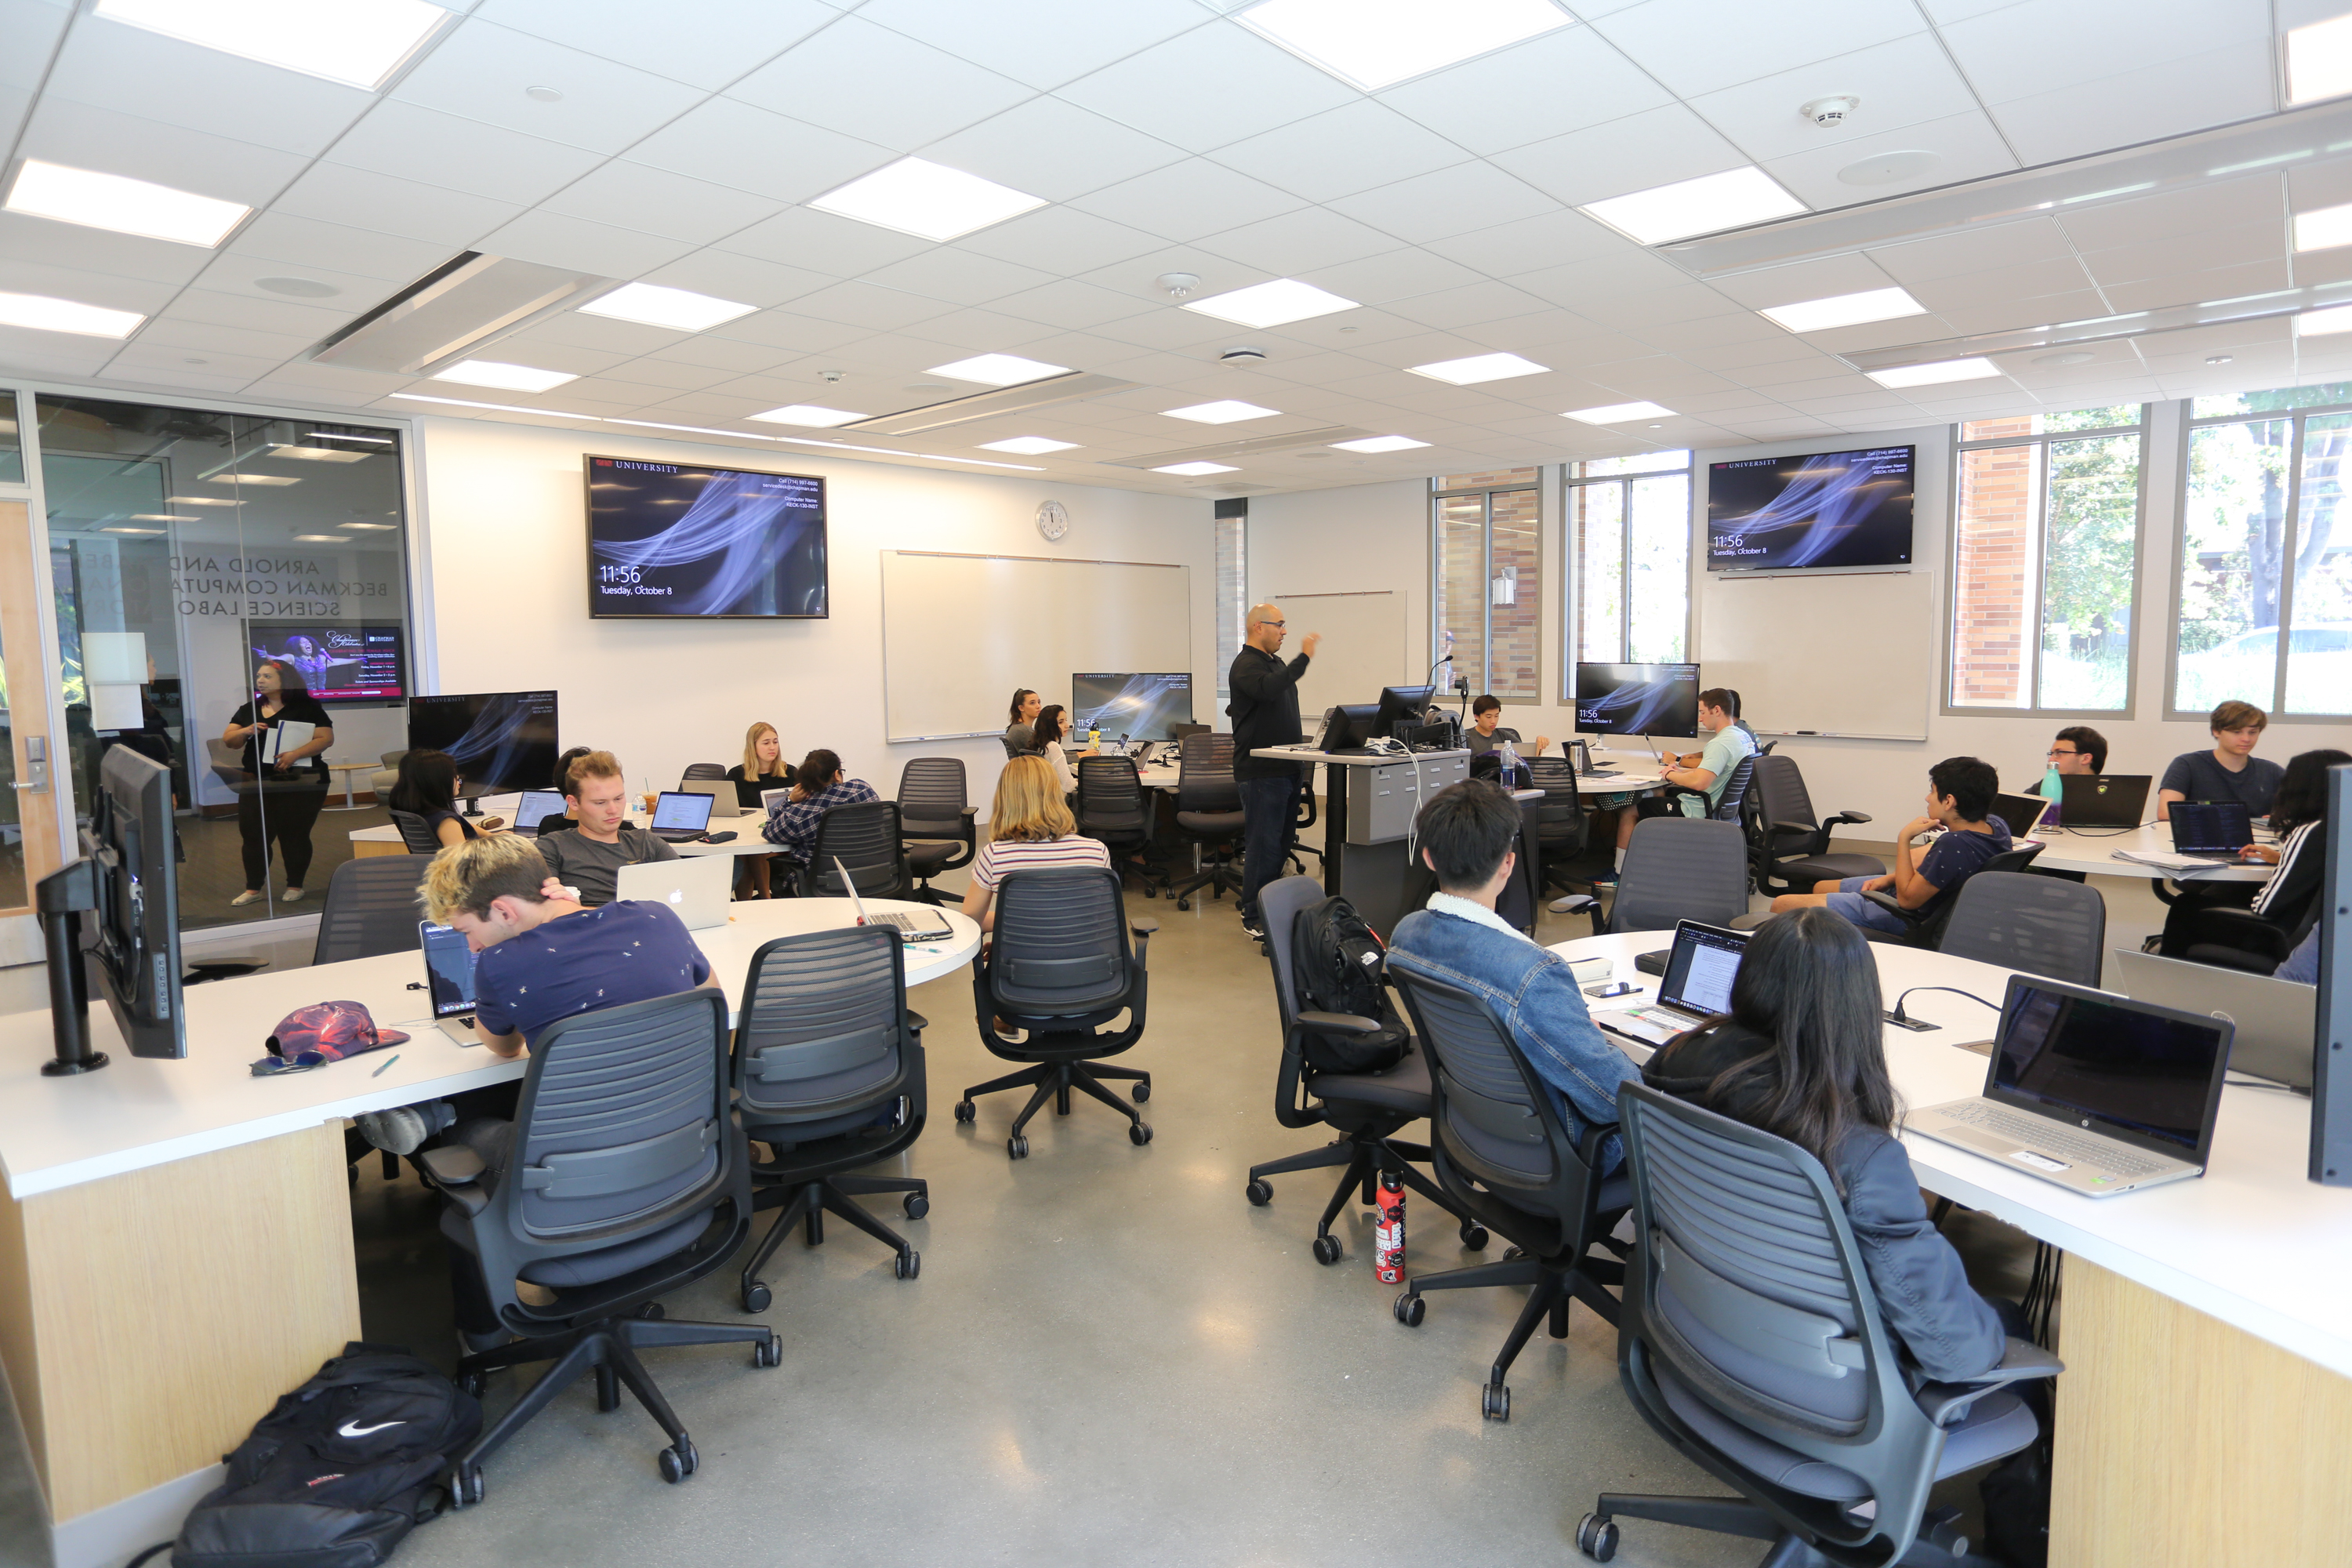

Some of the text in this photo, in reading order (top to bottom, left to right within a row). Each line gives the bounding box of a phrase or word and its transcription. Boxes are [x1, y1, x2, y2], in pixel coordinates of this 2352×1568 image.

[615, 461, 678, 473] UNIVERSITY
[1729, 459, 1777, 468] UNIVERSITY
[1713, 535, 1743, 548] 11:56
[600, 565, 641, 583] 11:56
[601, 586, 633, 597] Tuesday,
[634, 586, 665, 595] October
[1579, 710, 1598, 718] 11:56
